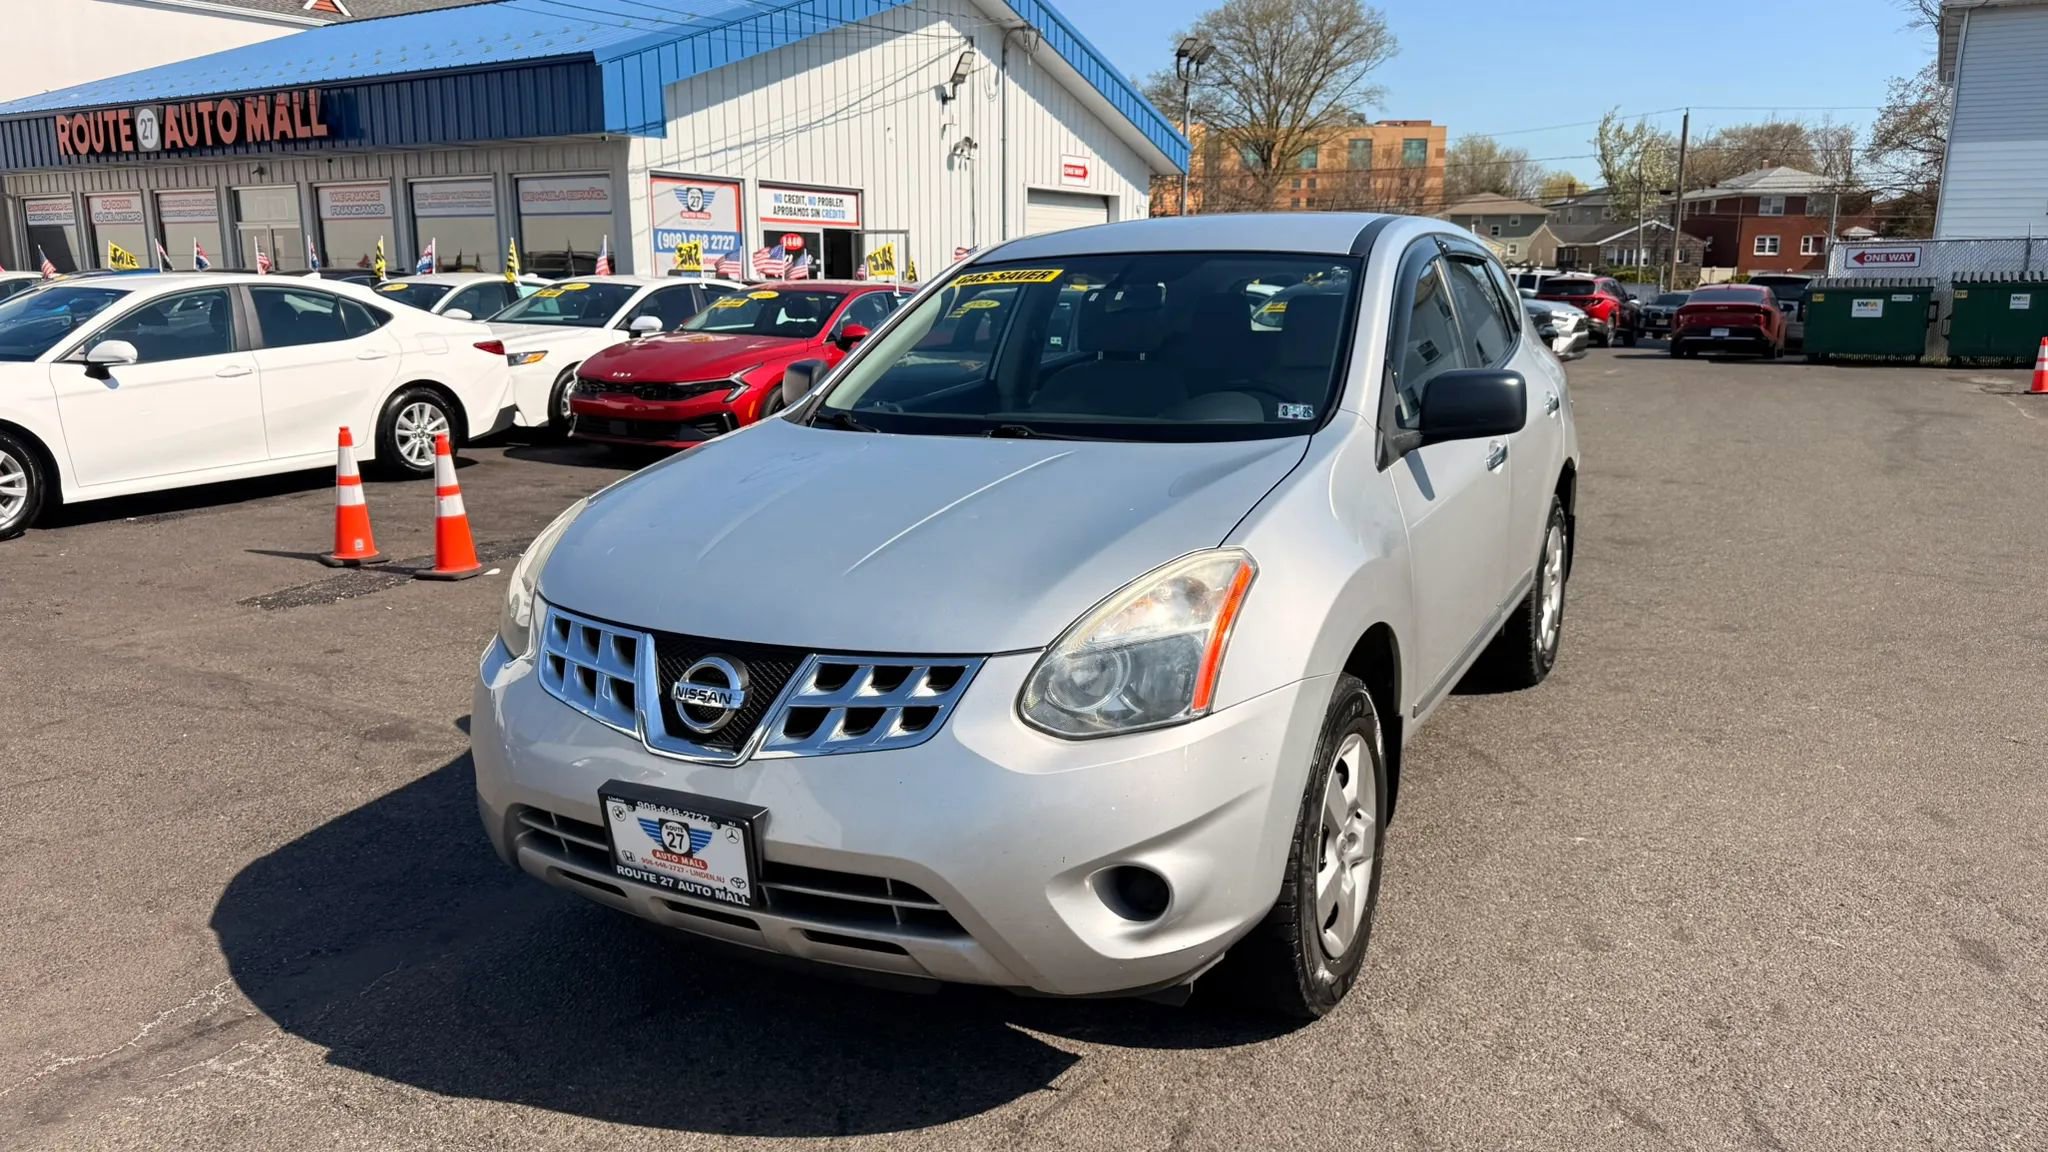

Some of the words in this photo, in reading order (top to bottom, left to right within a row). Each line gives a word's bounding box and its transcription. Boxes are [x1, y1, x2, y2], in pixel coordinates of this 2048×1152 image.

[55, 112, 134, 156] ROUTE
[140, 118, 154, 140] 27
[165, 98, 238, 149] AUTO
[245, 88, 328, 143] MALL
[690, 196, 701, 209] 27
[773, 206, 810, 217] APROBAMOS
[711, 234, 735, 251] 2727
[110, 247, 137, 267] SALE
[1864, 254, 1887, 263] ONE
[1888, 253, 1913, 263] WAY
[675, 686, 732, 705] NISSAN
[665, 824, 684, 833] ROUTE
[666, 831, 684, 850] 27
[655, 851, 679, 863] AUTO
[680, 856, 705, 869] MALL
[616, 864, 658, 884] ROUTE
[659, 876, 674, 887] 27
[678, 881, 711, 896] AUTO
[715, 888, 750, 906] MALL
